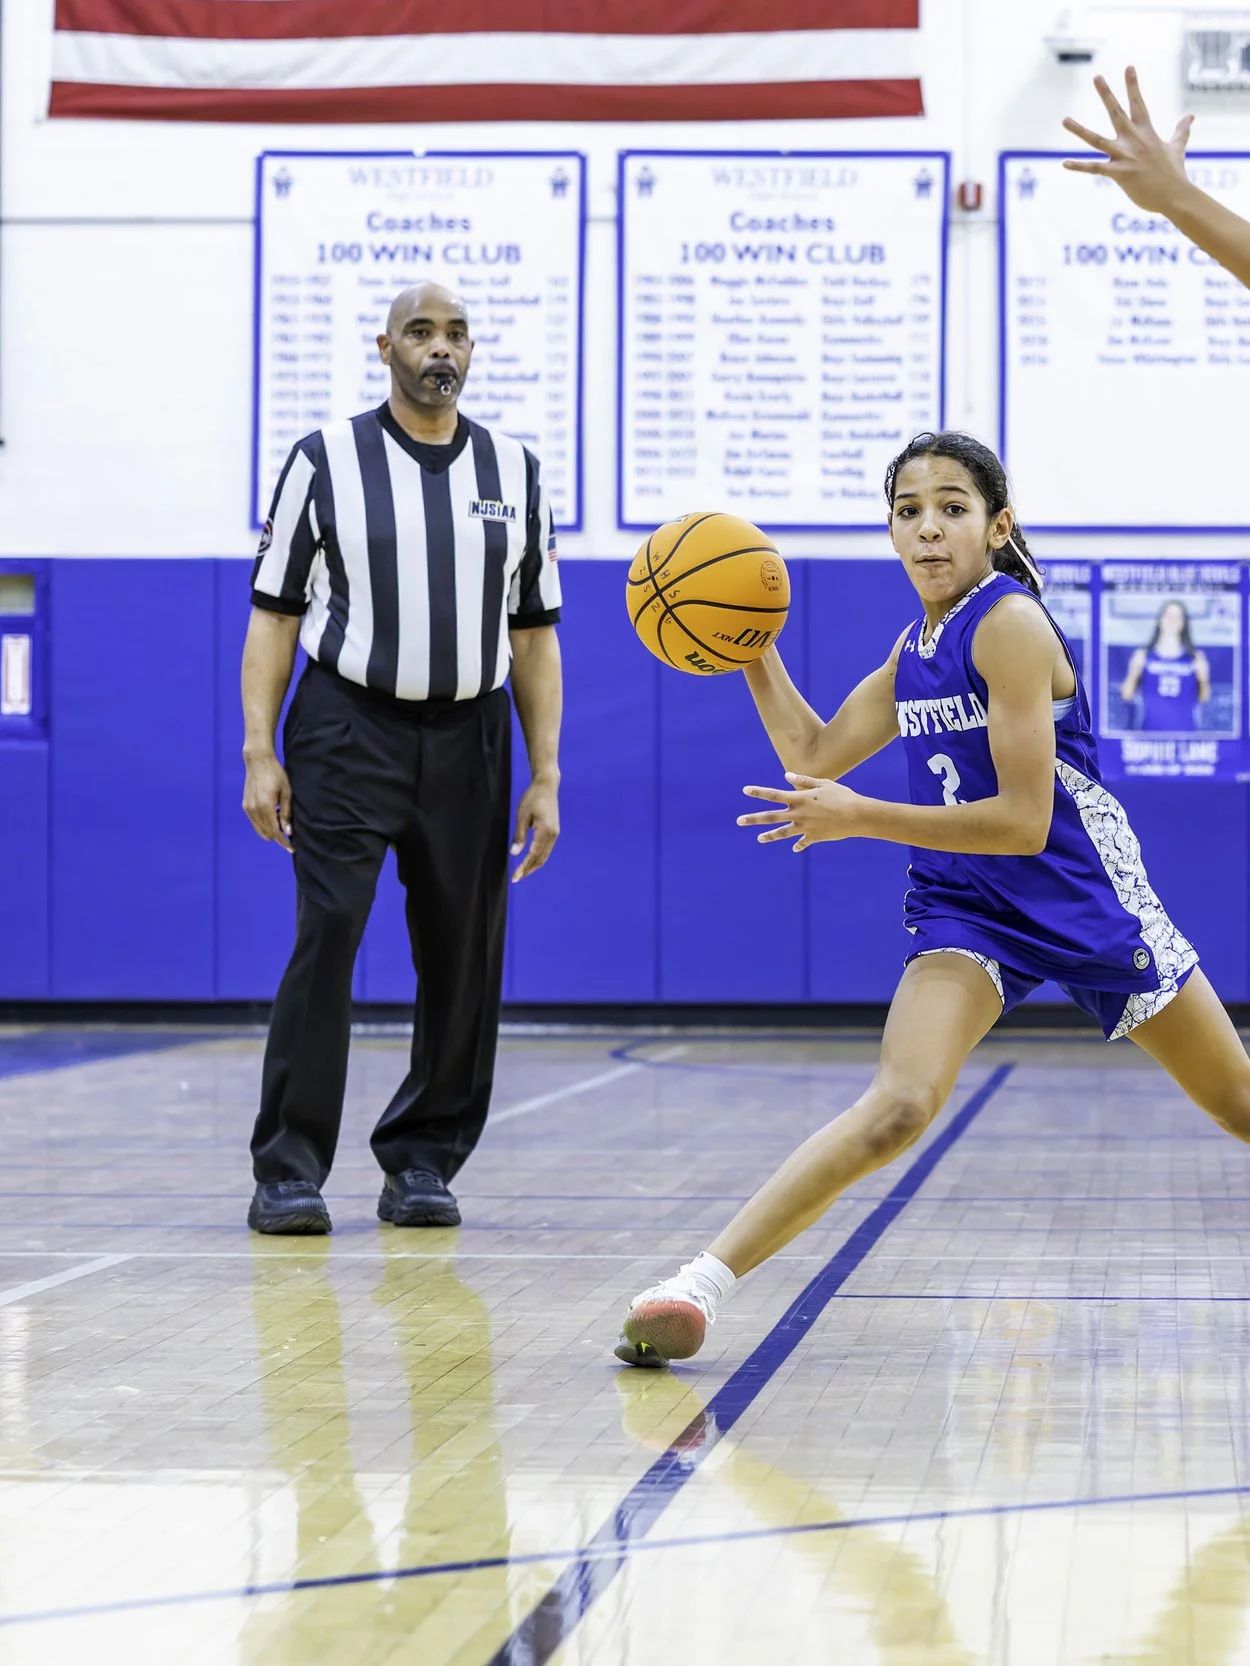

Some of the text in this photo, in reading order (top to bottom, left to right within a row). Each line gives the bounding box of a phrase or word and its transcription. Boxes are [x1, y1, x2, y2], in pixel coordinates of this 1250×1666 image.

[348, 167, 495, 189] WESTFIELD
[711, 167, 858, 189] WESTFIELD
[366, 212, 472, 233] Coaches
[730, 212, 835, 233] Coaches
[1111, 212, 1181, 234] Coac
[316, 243, 522, 264] 100 WIN CLUB
[680, 243, 886, 264] 100 WIN CLUB
[1063, 244, 1108, 265] 100
[1114, 245, 1179, 264] WIN
[471, 501, 516, 520] NJSIAA
[712, 631, 734, 643] NXT
[896, 692, 988, 738] ESTFIELD
[926, 753, 968, 806] 2
